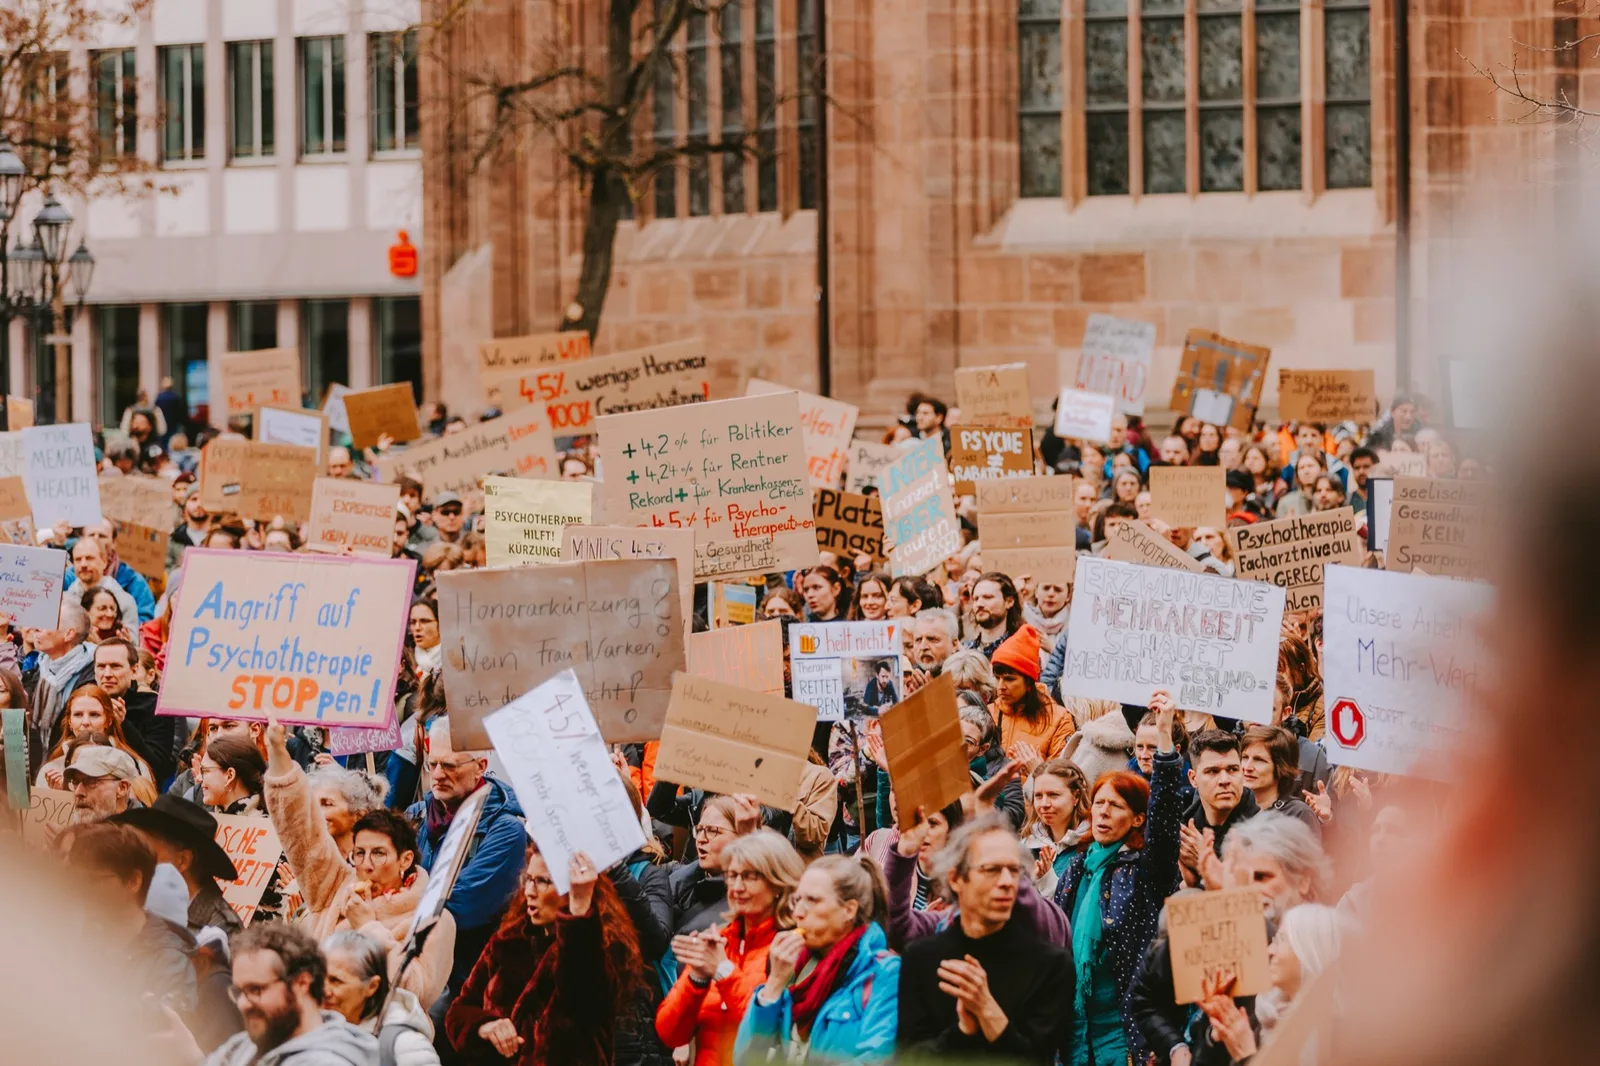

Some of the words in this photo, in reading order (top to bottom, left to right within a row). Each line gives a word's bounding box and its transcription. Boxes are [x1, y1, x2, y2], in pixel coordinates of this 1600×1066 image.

[575, 364, 642, 392] weniger
[546, 401, 592, 429] 100%
[699, 428, 720, 448] für
[728, 420, 794, 442] Politiker
[31, 446, 92, 471] MENTAL
[702, 457, 724, 478] für
[730, 450, 789, 470] Rentner
[877, 436, 944, 501] UNTER
[36, 475, 91, 500] HEALTH
[693, 484, 714, 505] für
[769, 485, 805, 502] Chefs
[332, 500, 393, 520] EXPERTISE
[494, 510, 584, 527] PSYCHOTHERAPIE
[703, 507, 723, 529] für
[321, 528, 347, 545] KEIN
[523, 528, 556, 542] HILFT!
[1236, 514, 1353, 551] Psychotherapie
[1421, 523, 1466, 543] KEIN
[507, 540, 562, 558] KÜRZUNGE
[706, 537, 772, 559] Gesundheit
[1082, 560, 1271, 616] ERZWUNGENE
[192, 579, 306, 631] Angriff
[316, 587, 361, 629] auf
[1346, 594, 1403, 630] Unsere
[1091, 595, 1266, 645] MEHRARBEIT
[824, 626, 853, 655] heilt
[1102, 628, 1235, 669] SCHADET
[185, 625, 373, 686] Psychotherapie
[461, 638, 518, 673] Nein
[537, 638, 574, 667] Frau
[795, 660, 833, 676] Therapie
[1066, 650, 1176, 686] MENTALER
[1357, 637, 1480, 697] Mehr-Wert
[464, 690, 490, 709] ich
[798, 678, 839, 695] RETTET
[1179, 684, 1230, 709] HEIT
[1367, 703, 1407, 728] STOPPT
[529, 770, 553, 801] mehr
[25, 793, 76, 826] PSYC
[589, 799, 623, 855] Honorar
